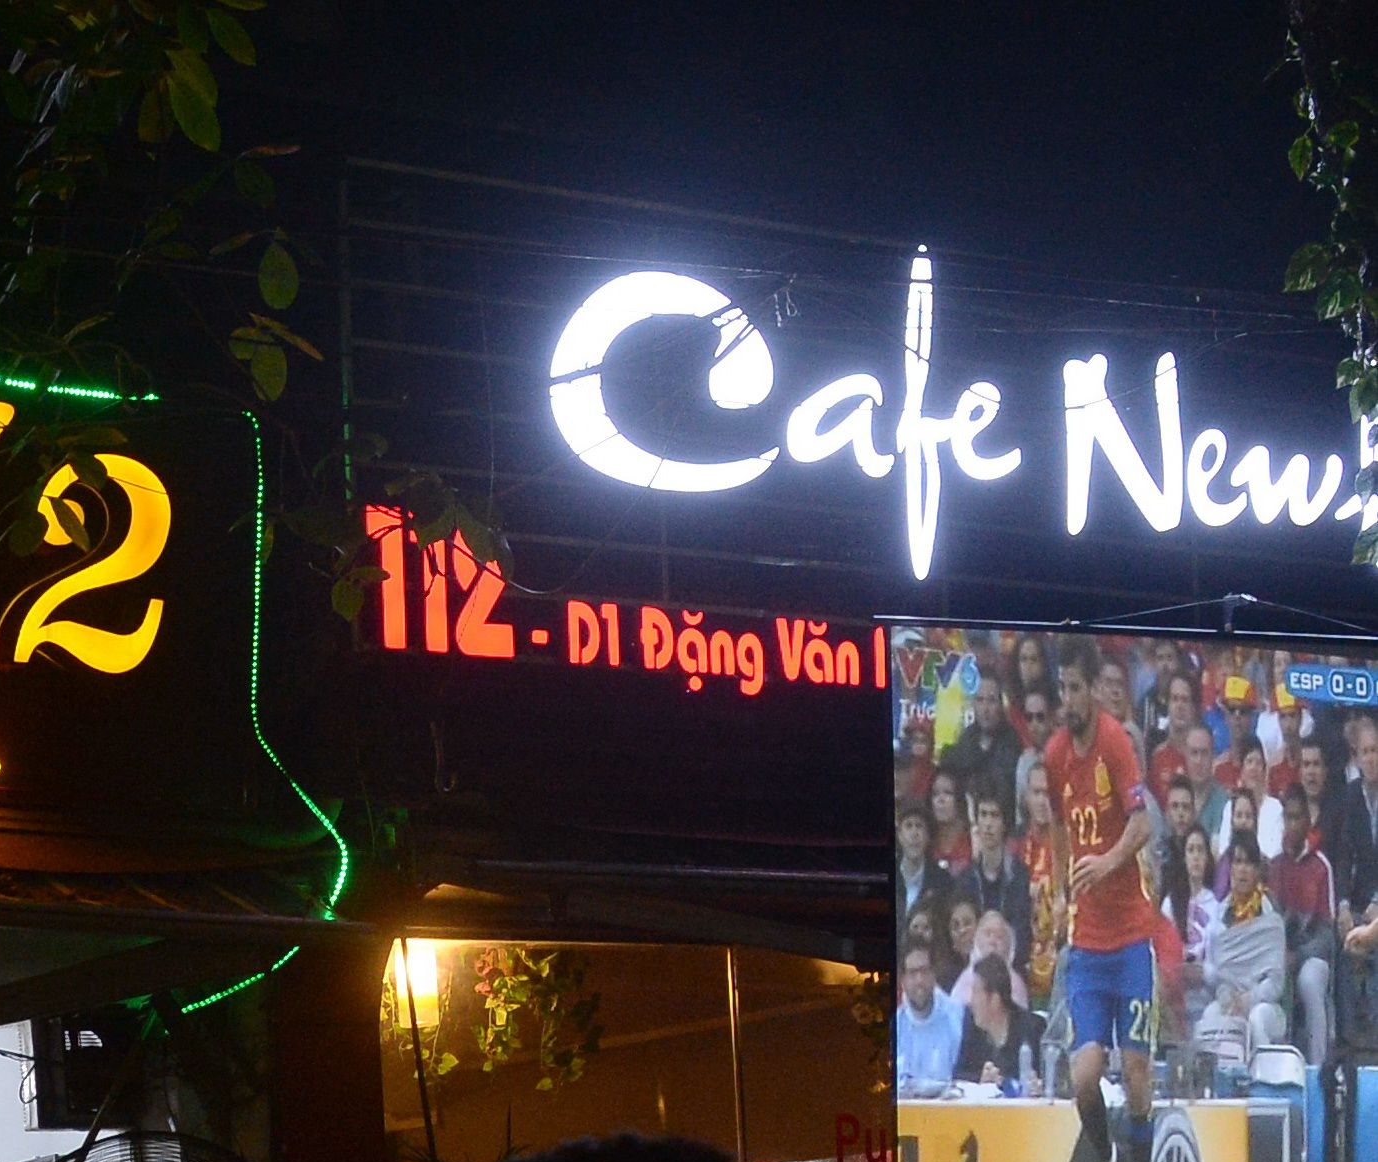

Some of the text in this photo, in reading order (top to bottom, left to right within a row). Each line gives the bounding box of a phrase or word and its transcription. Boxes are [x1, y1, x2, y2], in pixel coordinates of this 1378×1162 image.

[549, 244, 1022, 581] Cafe
[13, 452, 173, 675] 2
[365, 503, 516, 659] 112
[567, 600, 621, 668] D1
[639, 605, 765, 697] Đặng
[775, 617, 861, 688] Văn
[1290, 671, 1324, 690] ESP
[1071, 805, 1103, 846] 22
